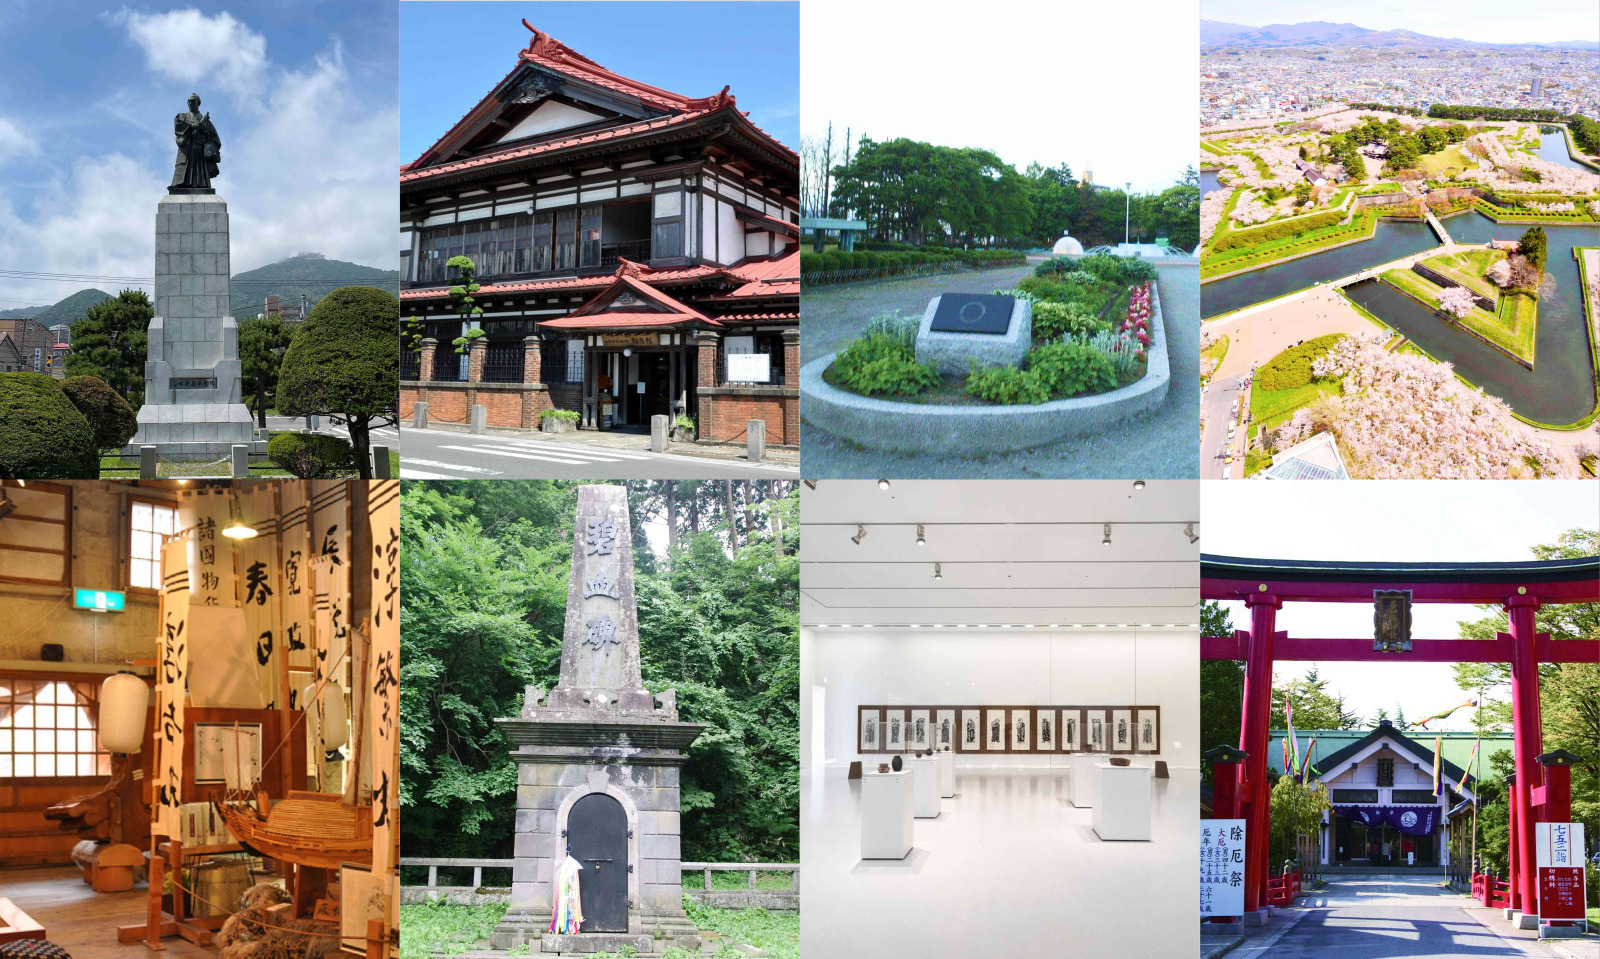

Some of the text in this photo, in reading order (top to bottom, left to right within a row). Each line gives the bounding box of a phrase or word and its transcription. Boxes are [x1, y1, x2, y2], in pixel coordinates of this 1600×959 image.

[582, 517, 621, 657] 碧血碑
[1202, 828, 1212, 847] 厄年
[1217, 828, 1227, 847] 大厄
[1229, 825, 1244, 888] 除厄祭
[1553, 824, 1568, 863] 七五三詣
